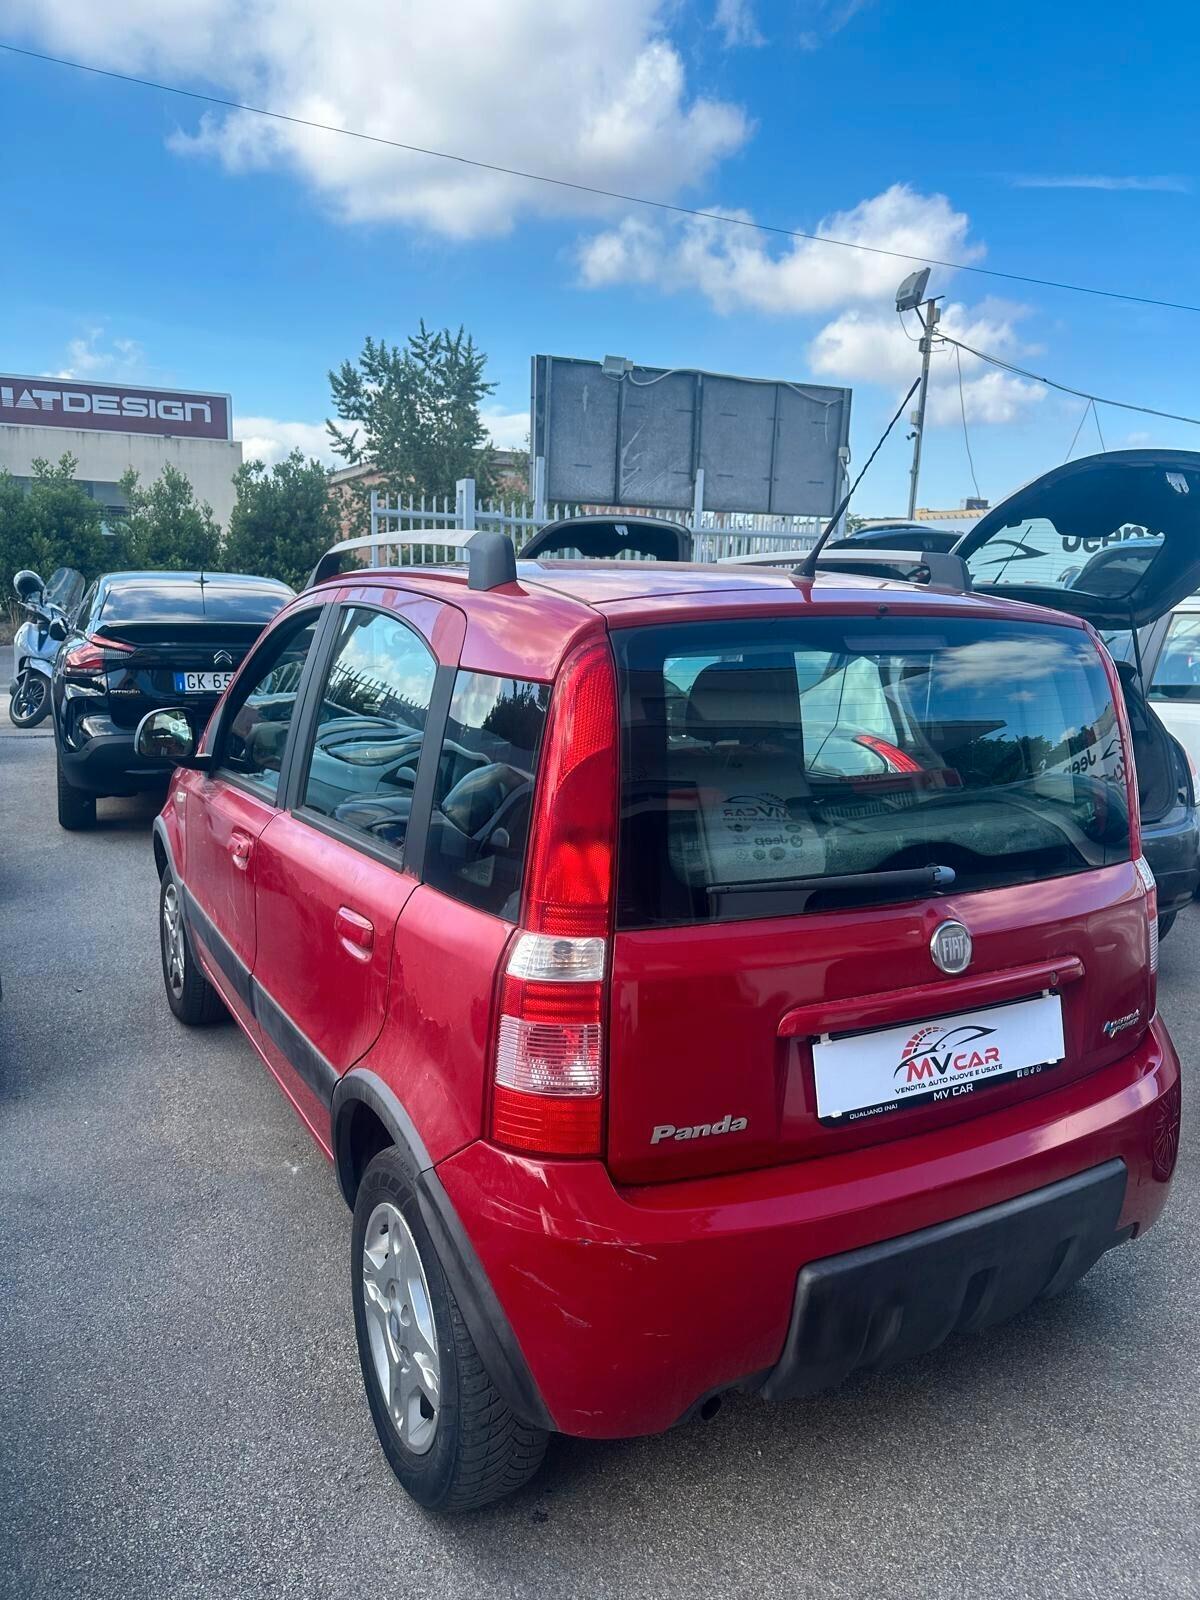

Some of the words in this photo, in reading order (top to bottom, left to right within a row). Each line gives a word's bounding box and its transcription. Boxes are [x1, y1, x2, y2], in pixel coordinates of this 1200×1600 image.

[187, 674, 206, 689] GK
[213, 673, 235, 689] 65
[942, 935, 963, 961] FIAT
[894, 1082, 926, 1094] VENDITA
[928, 1077, 948, 1087] AUTO
[949, 1070, 974, 1082] NUOVE
[981, 1063, 1003, 1074] USATE
[934, 1089, 949, 1101] MV
[952, 1083, 974, 1096] CAR
[849, 1104, 883, 1120] QUALIANO
[650, 1114, 748, 1144] Panda
